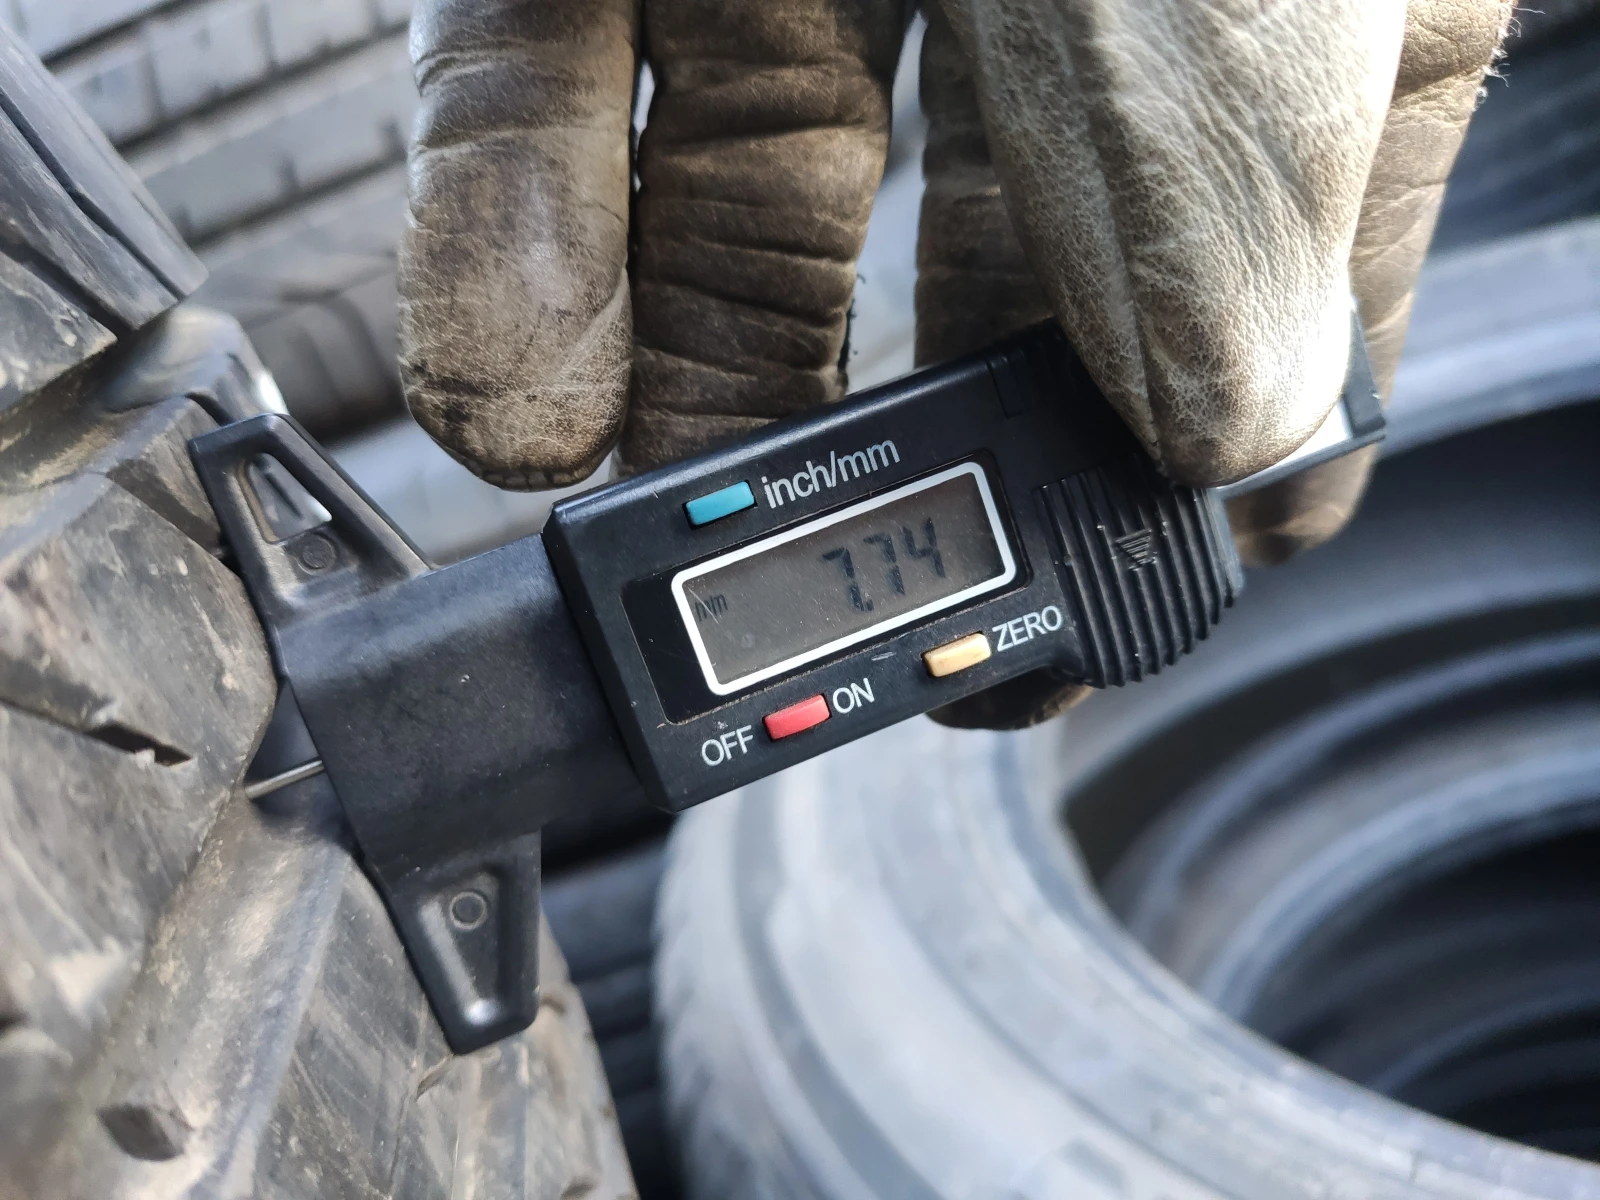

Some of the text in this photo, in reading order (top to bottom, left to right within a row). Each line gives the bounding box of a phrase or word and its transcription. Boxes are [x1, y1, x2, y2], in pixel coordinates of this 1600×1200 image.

[762, 439, 900, 508] inch/mm
[992, 605, 1062, 652] ZERO
[701, 678, 875, 766] OFF ON
